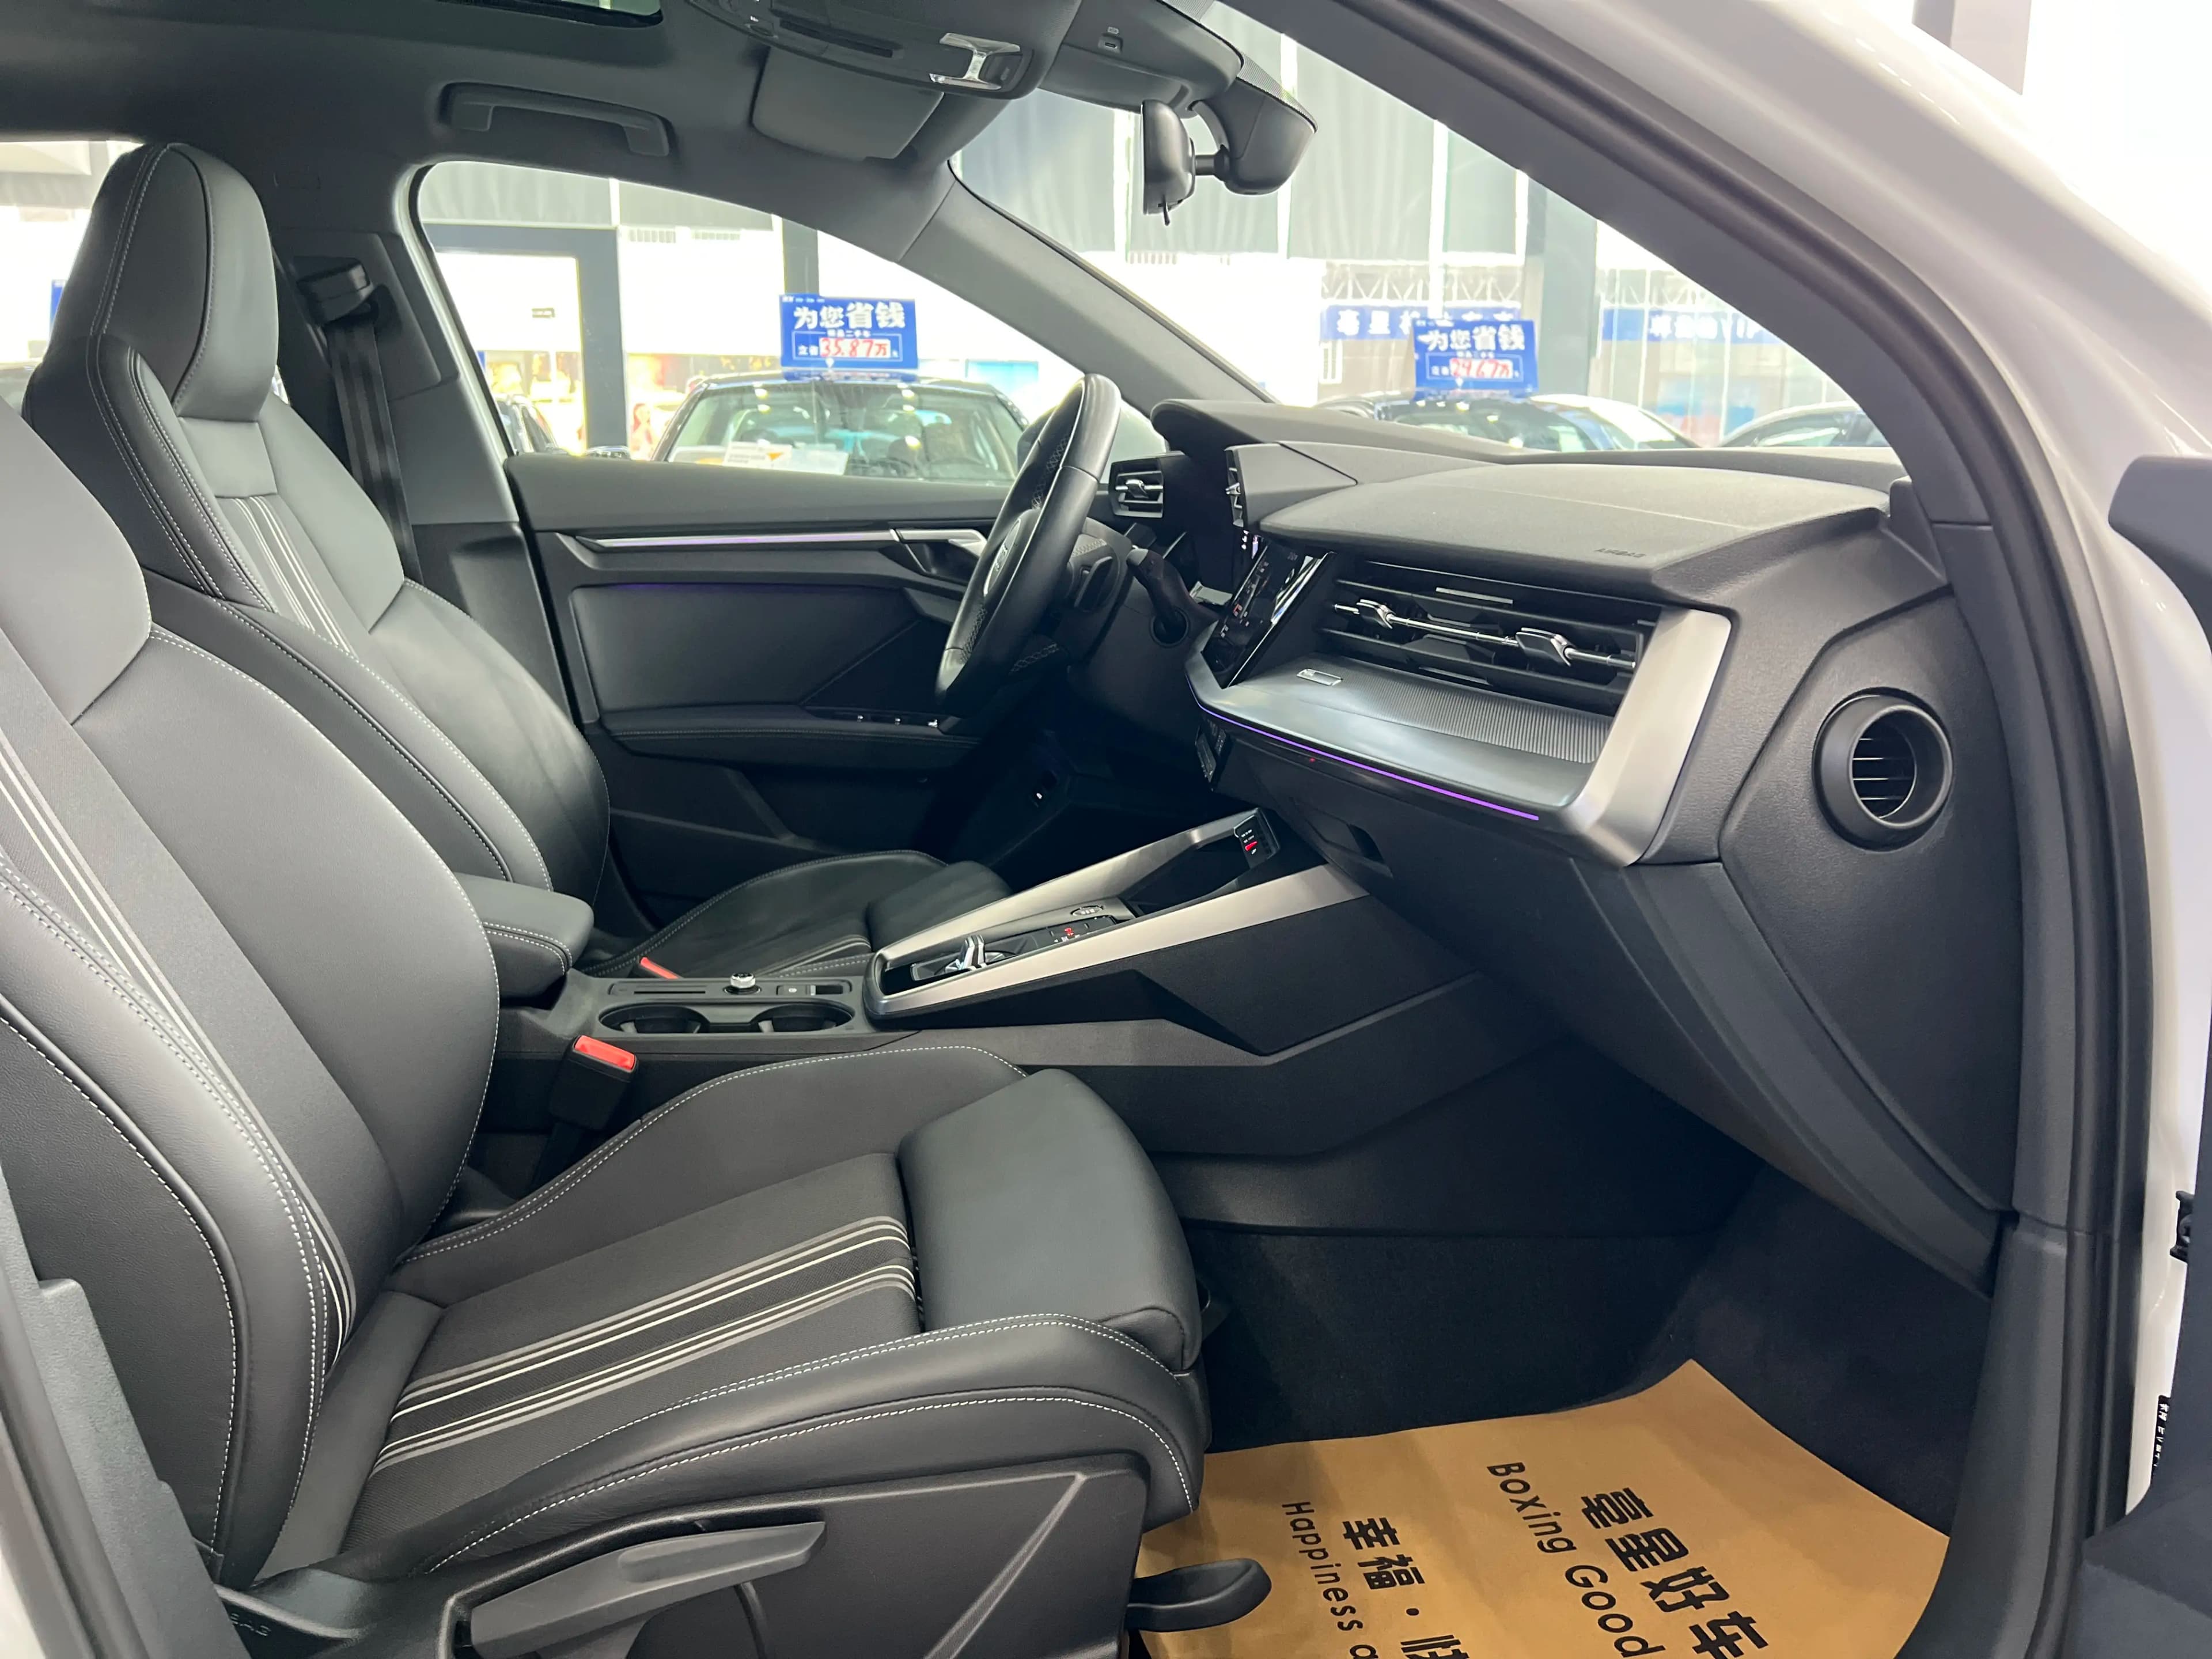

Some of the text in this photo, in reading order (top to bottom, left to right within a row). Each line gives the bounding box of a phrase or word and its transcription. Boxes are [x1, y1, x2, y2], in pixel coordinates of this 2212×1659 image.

[794, 302, 906, 329] 为您省钱
[1423, 324, 1525, 351] 为您省钱
[1282, 1501, 1363, 1631] Happiness
[1487, 1462, 1666, 1658] Boxing Good
